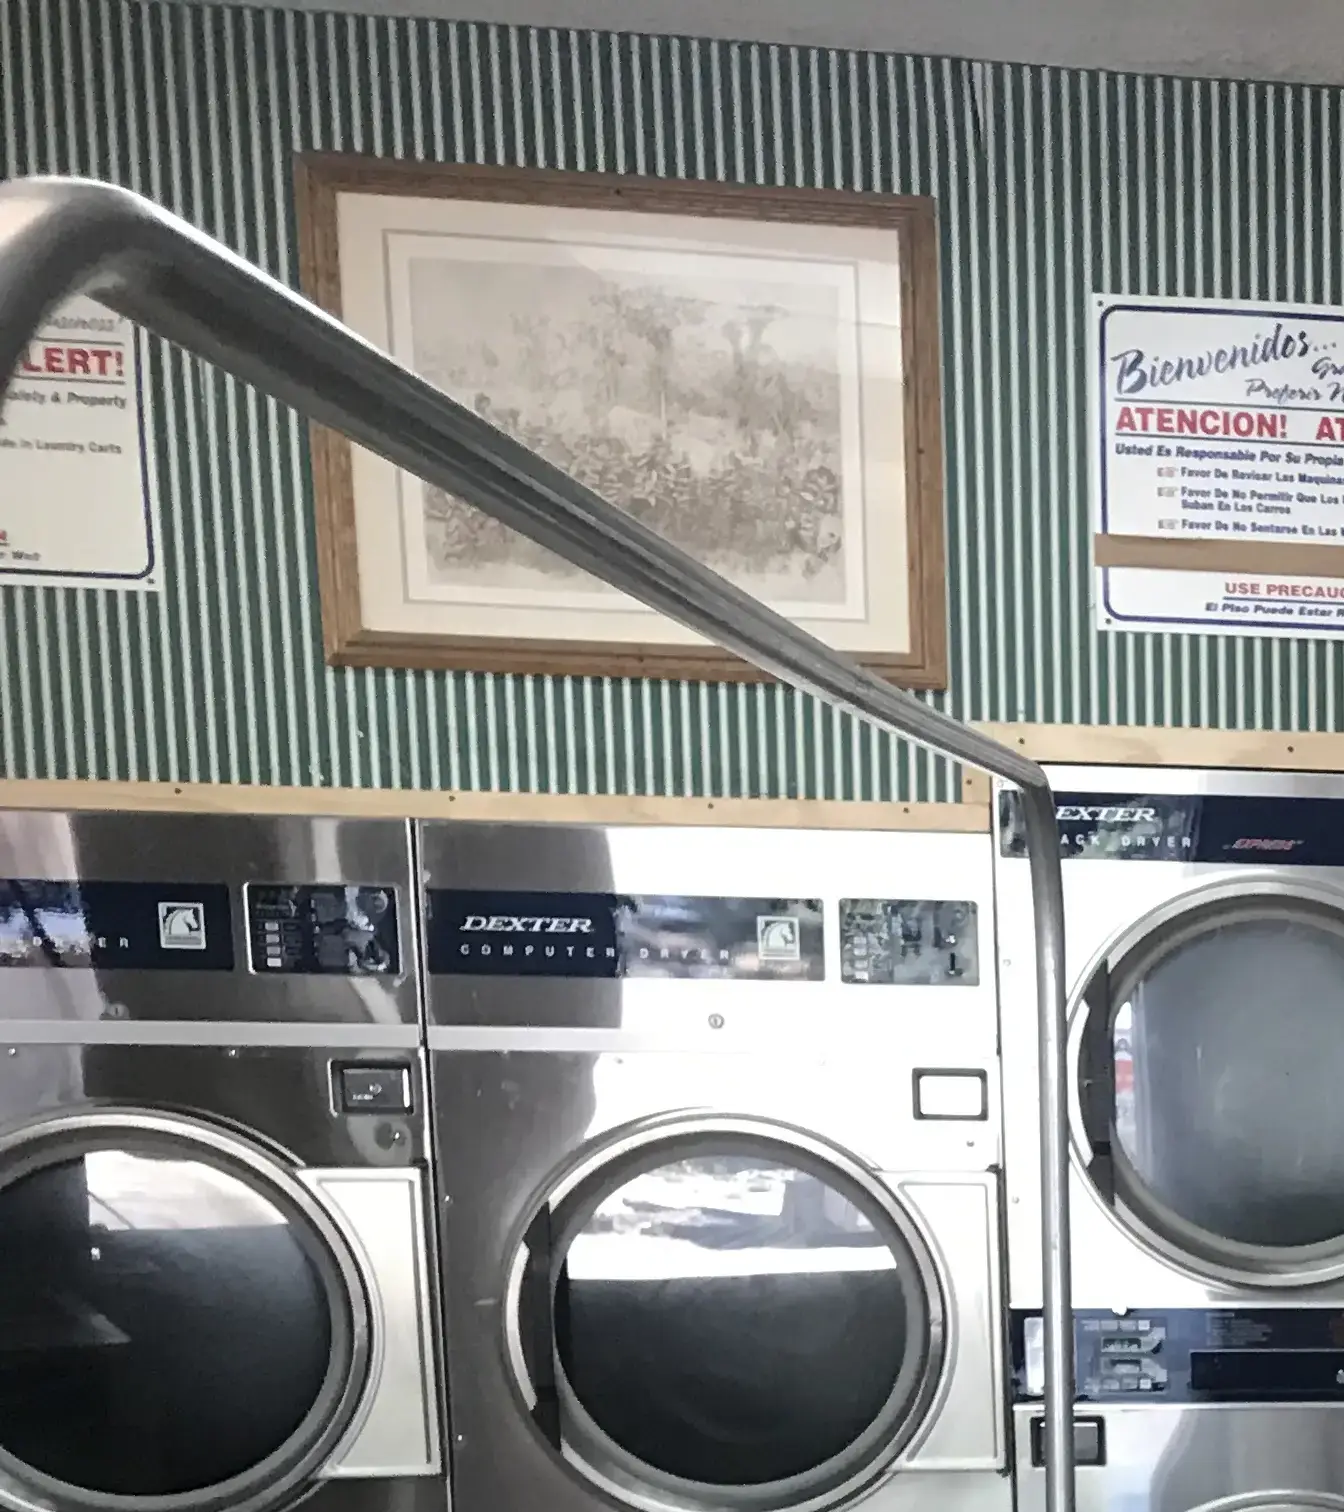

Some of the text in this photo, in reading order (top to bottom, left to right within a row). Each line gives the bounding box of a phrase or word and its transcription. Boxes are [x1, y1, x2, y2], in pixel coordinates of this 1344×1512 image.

[21, 347, 125, 376] LERT!
[1245, 378, 1322, 404] Preferir
[1116, 406, 1288, 438] ATENCION!
[1115, 443, 1153, 457] Usted
[1157, 445, 1172, 457] Es
[1175, 446, 1256, 462] Responsable
[1260, 451, 1282, 463] Por
[1285, 451, 1300, 464] Su
[1304, 453, 1344, 467] Propia
[1181, 466, 1211, 478] Favor
[1214, 468, 1228, 479] De
[1275, 471, 1294, 482] Las
[1181, 486, 1211, 498] Favor
[1214, 487, 1228, 499] De
[1232, 489, 1246, 500] No
[1296, 492, 1317, 504] Que
[1320, 493, 1338, 504] Los
[1217, 500, 1231, 511] En
[1234, 502, 1253, 512] Los
[1256, 503, 1291, 514] Carros
[1181, 519, 1212, 530] Favor
[1215, 520, 1228, 531] De
[1232, 521, 1247, 532] No
[1302, 524, 1315, 535] En
[1318, 526, 1337, 536] Las
[1224, 582, 1260, 595] USE
[1205, 602, 1218, 612] El
[1222, 604, 1249, 613] Piso
[1254, 605, 1293, 615] Puede
[1055, 805, 1157, 821] EXTER
[1060, 833, 1192, 849] ACK DRYER
[459, 915, 594, 934] DEXTER
[460, 943, 729, 959] COMPUTER DRYER
